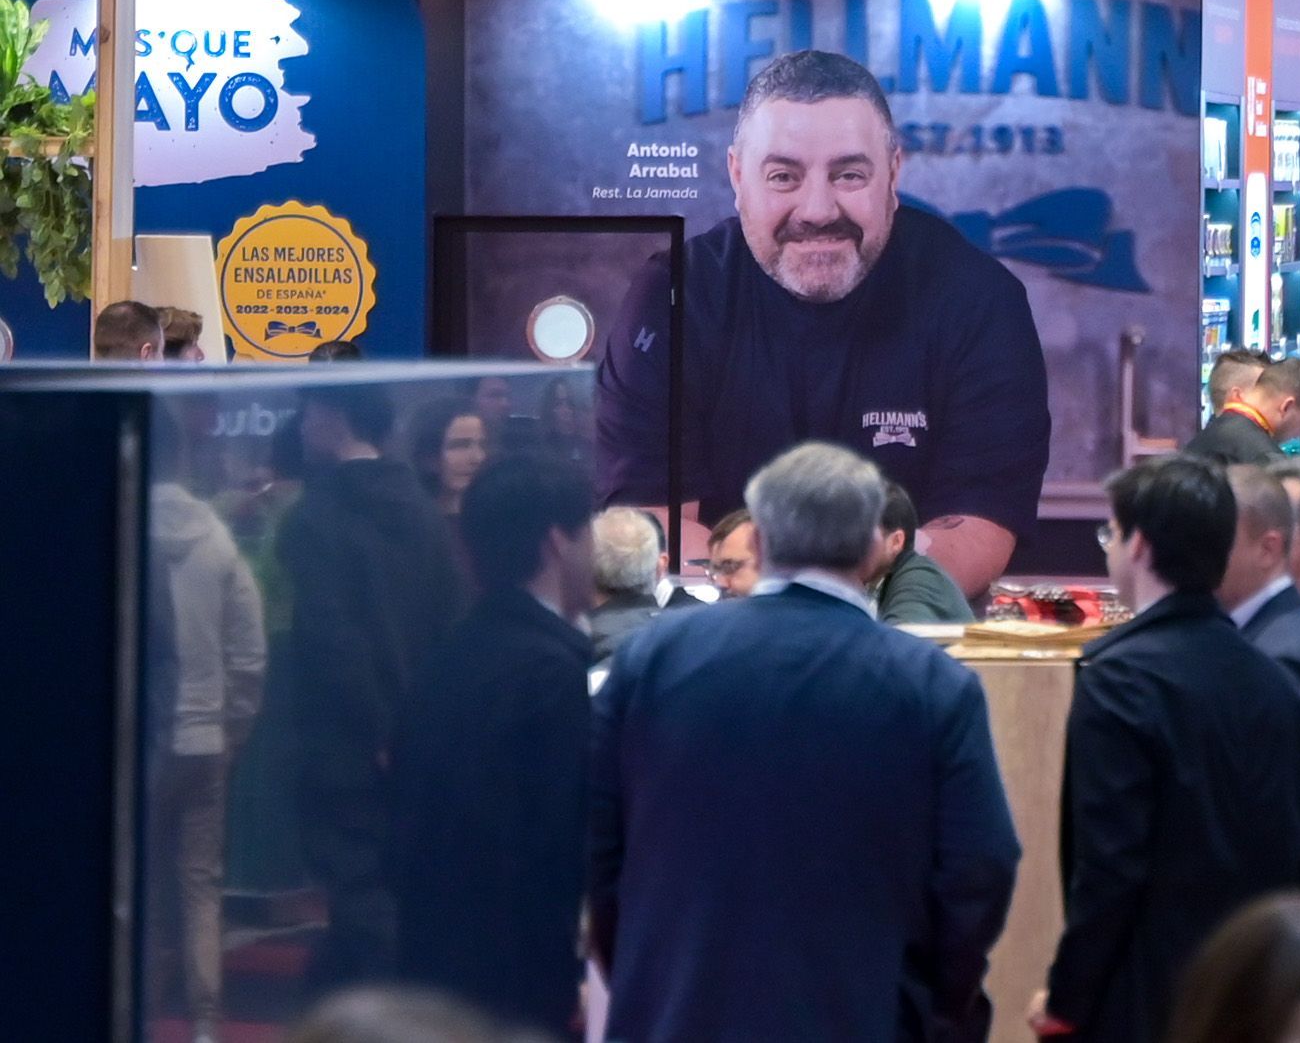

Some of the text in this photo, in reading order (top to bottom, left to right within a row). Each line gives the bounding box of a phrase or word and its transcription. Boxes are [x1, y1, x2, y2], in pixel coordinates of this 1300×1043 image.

[69, 27, 251, 72] MS'QUE
[901, 121, 1065, 155] ST.1913
[626, 142, 699, 157] Antonio
[628, 163, 699, 178] Arrabal
[592, 187, 699, 199] Rest. La Jamada
[242, 246, 345, 262] LAS MEJORES
[233, 267, 353, 284] ENSALADILLAS
[256, 289, 273, 299] DE
[862, 411, 927, 428] HELLMANN'S
